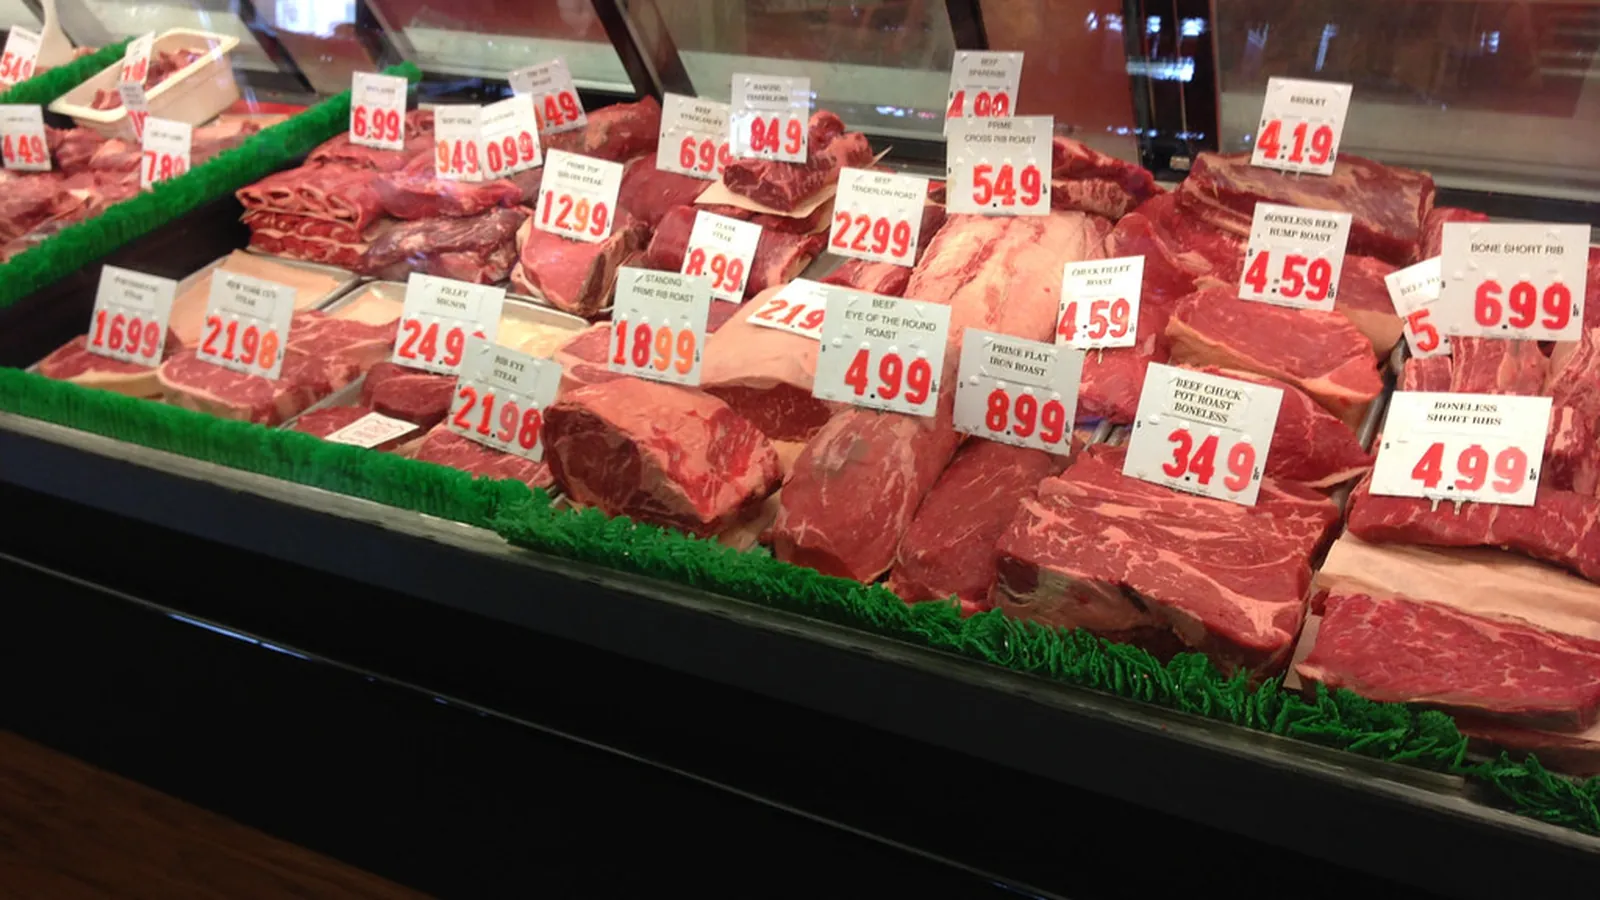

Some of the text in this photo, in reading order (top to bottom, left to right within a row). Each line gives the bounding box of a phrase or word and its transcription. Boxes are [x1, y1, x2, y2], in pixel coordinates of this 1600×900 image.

[1290, 95, 1327, 107] BRISKET
[535, 91, 579, 132] .49
[353, 105, 400, 142] 6.99
[987, 121, 1012, 130] PRIME
[964, 135, 1036, 144] CROSS RIB ROAST
[1257, 119, 1332, 165] 4.19
[874, 176, 892, 185] BEEF
[972, 164, 1041, 207] 5.49
[893, 188, 917, 200] ROAST
[1264, 213, 1340, 230] BONELESS BEEF
[1269, 226, 1332, 243] RUMP ROAST
[1470, 243, 1564, 255] BONE SHORT RIB
[645, 274, 682, 287] STANDING
[1244, 250, 1332, 302] 4.59
[440, 285, 469, 299] FILLET
[632, 286, 694, 303] PRIME RIB ROAST
[436, 297, 467, 310] MIGNON
[872, 299, 897, 310] BEEF
[1474, 279, 1571, 330] 6.99
[756, 300, 826, 332] 21.9
[845, 310, 937, 333] EYE OF THE ROUND
[1058, 298, 1130, 341] 4.59
[398, 319, 486, 366] 24.9
[865, 326, 897, 340] ROAST
[991, 342, 1050, 362] PRIME FLAT
[495, 355, 525, 371] RIB EYE
[989, 355, 1048, 377] IRON ROAST
[493, 369, 518, 384] STEAK
[845, 349, 932, 405] 4.99
[1175, 377, 1244, 401] BEEF CHUCK
[1173, 389, 1234, 412] POT ROAST
[1434, 401, 1497, 412] BONELESS
[986, 388, 1065, 444] 8.99
[1174, 402, 1229, 424] BONELESS
[1427, 413, 1502, 426] SHORT RIBS
[1162, 428, 1256, 492] 3.49
[1412, 442, 1527, 493] 4.99
